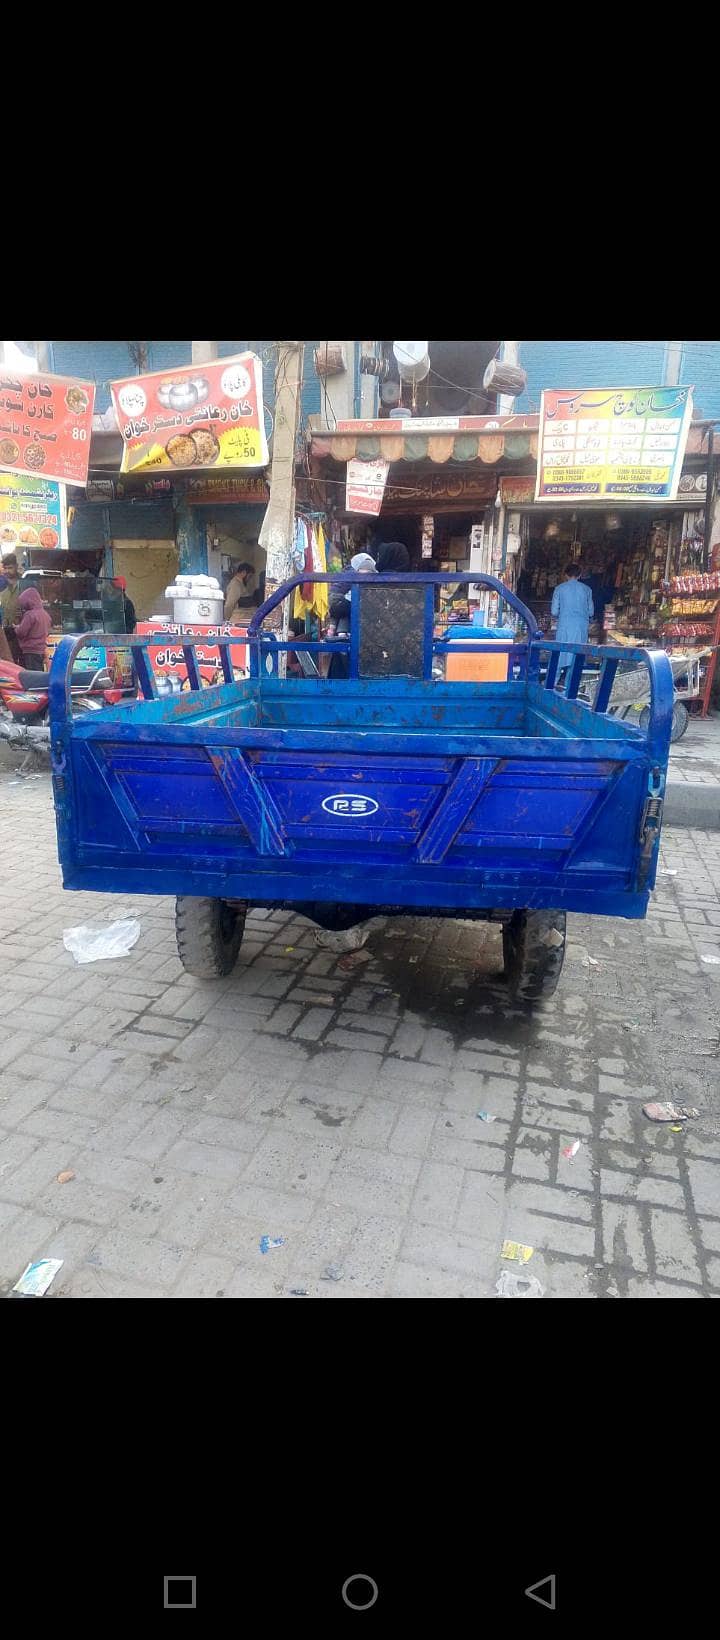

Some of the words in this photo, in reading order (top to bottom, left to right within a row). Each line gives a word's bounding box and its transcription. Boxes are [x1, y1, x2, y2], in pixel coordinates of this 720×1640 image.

[230, 401, 252, 420] خان
[72, 427, 87, 441] 80
[124, 418, 150, 440] خوان
[243, 446, 256, 458] 50
